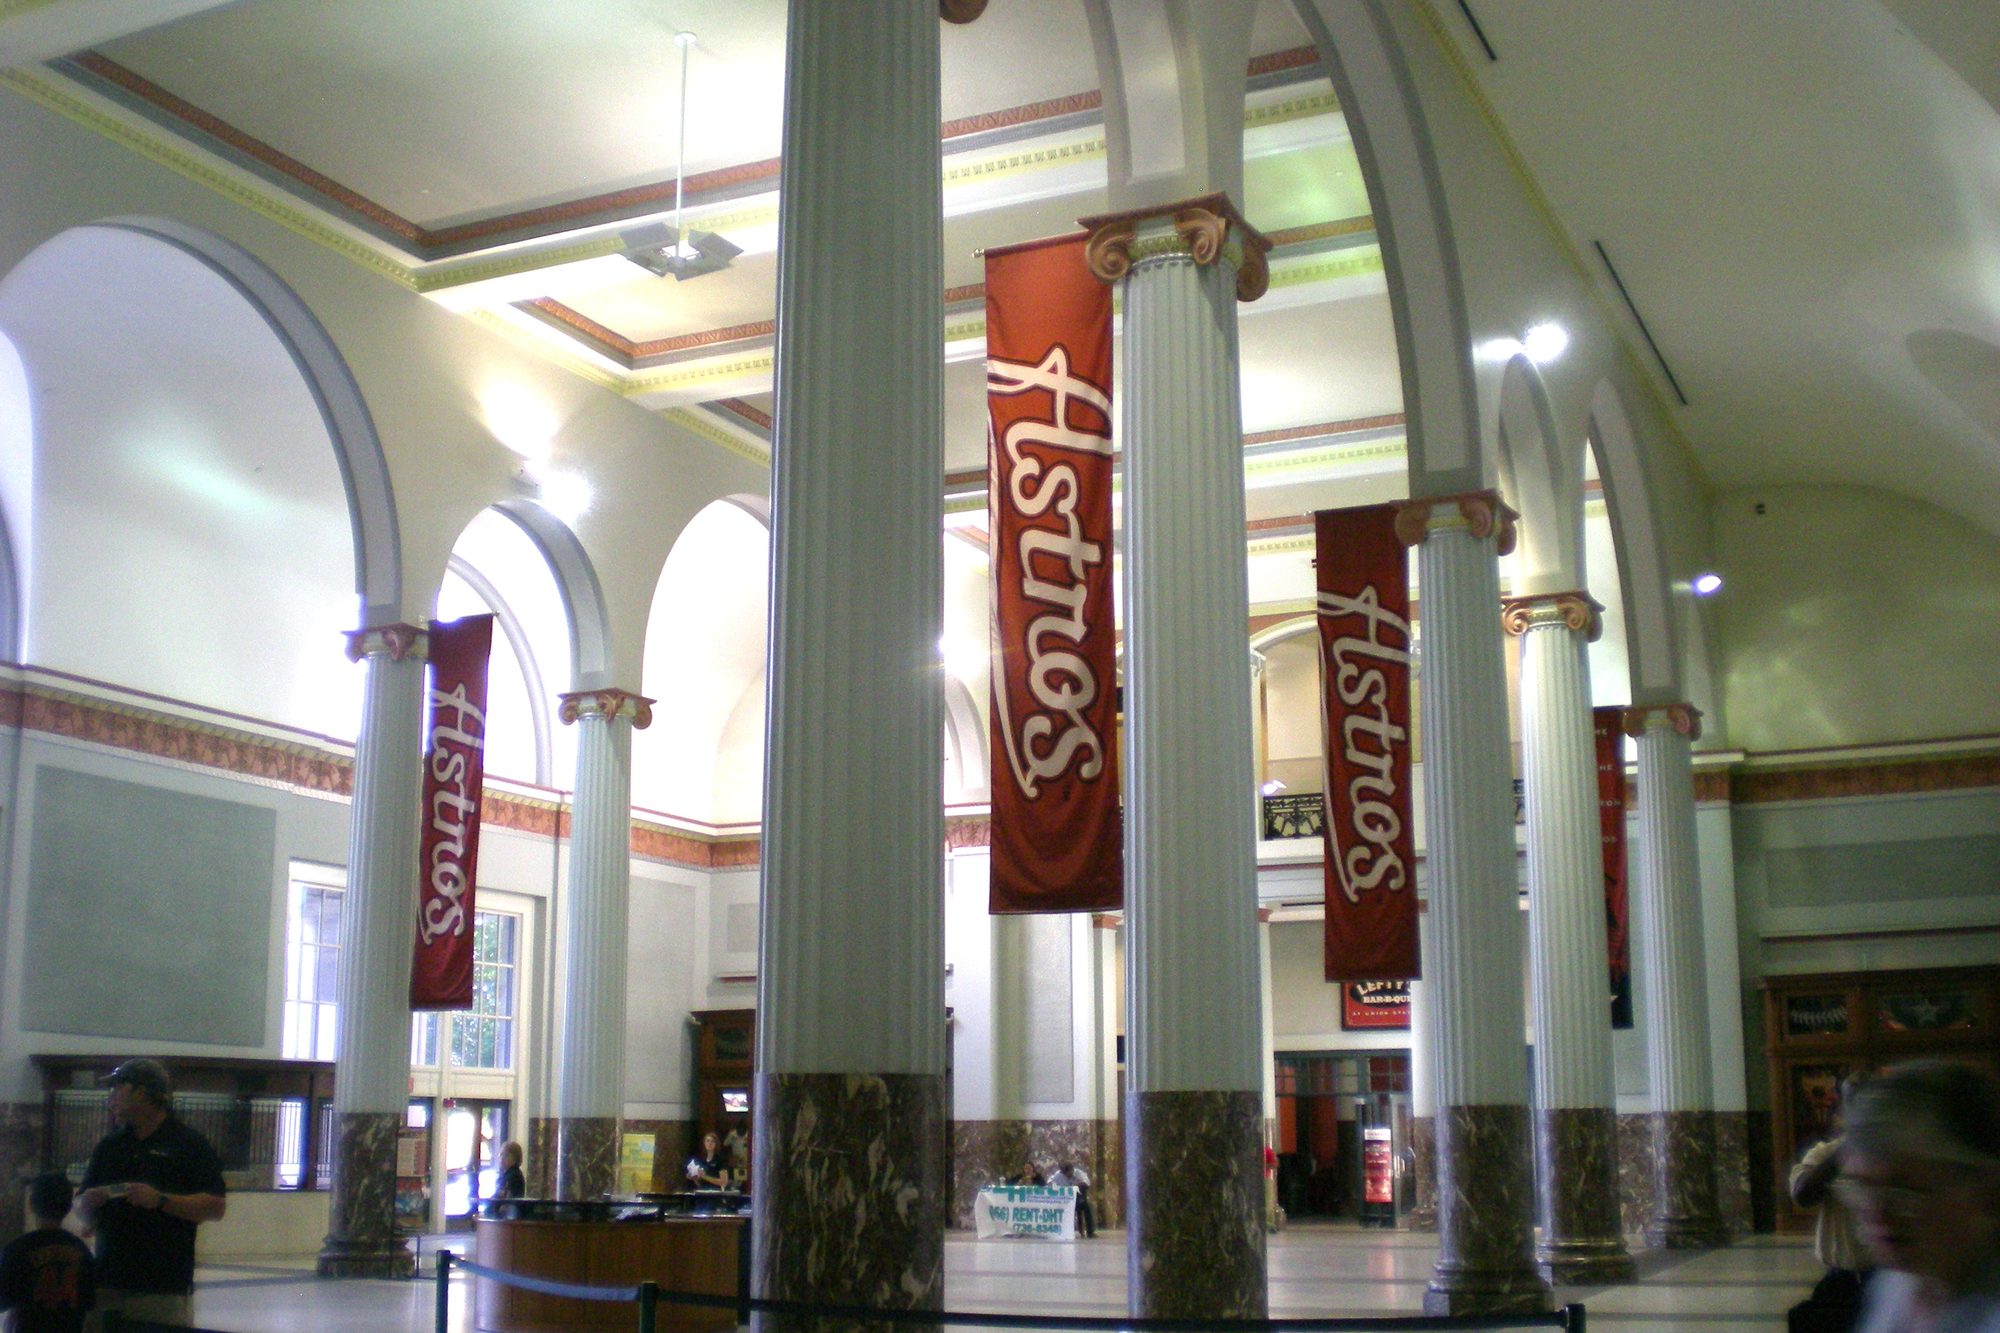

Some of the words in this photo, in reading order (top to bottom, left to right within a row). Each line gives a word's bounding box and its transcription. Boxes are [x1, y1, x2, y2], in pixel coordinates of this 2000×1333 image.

[987, 343, 1114, 798] Astros
[419, 682, 486, 945] Astros
[1317, 584, 1411, 903] Astros
